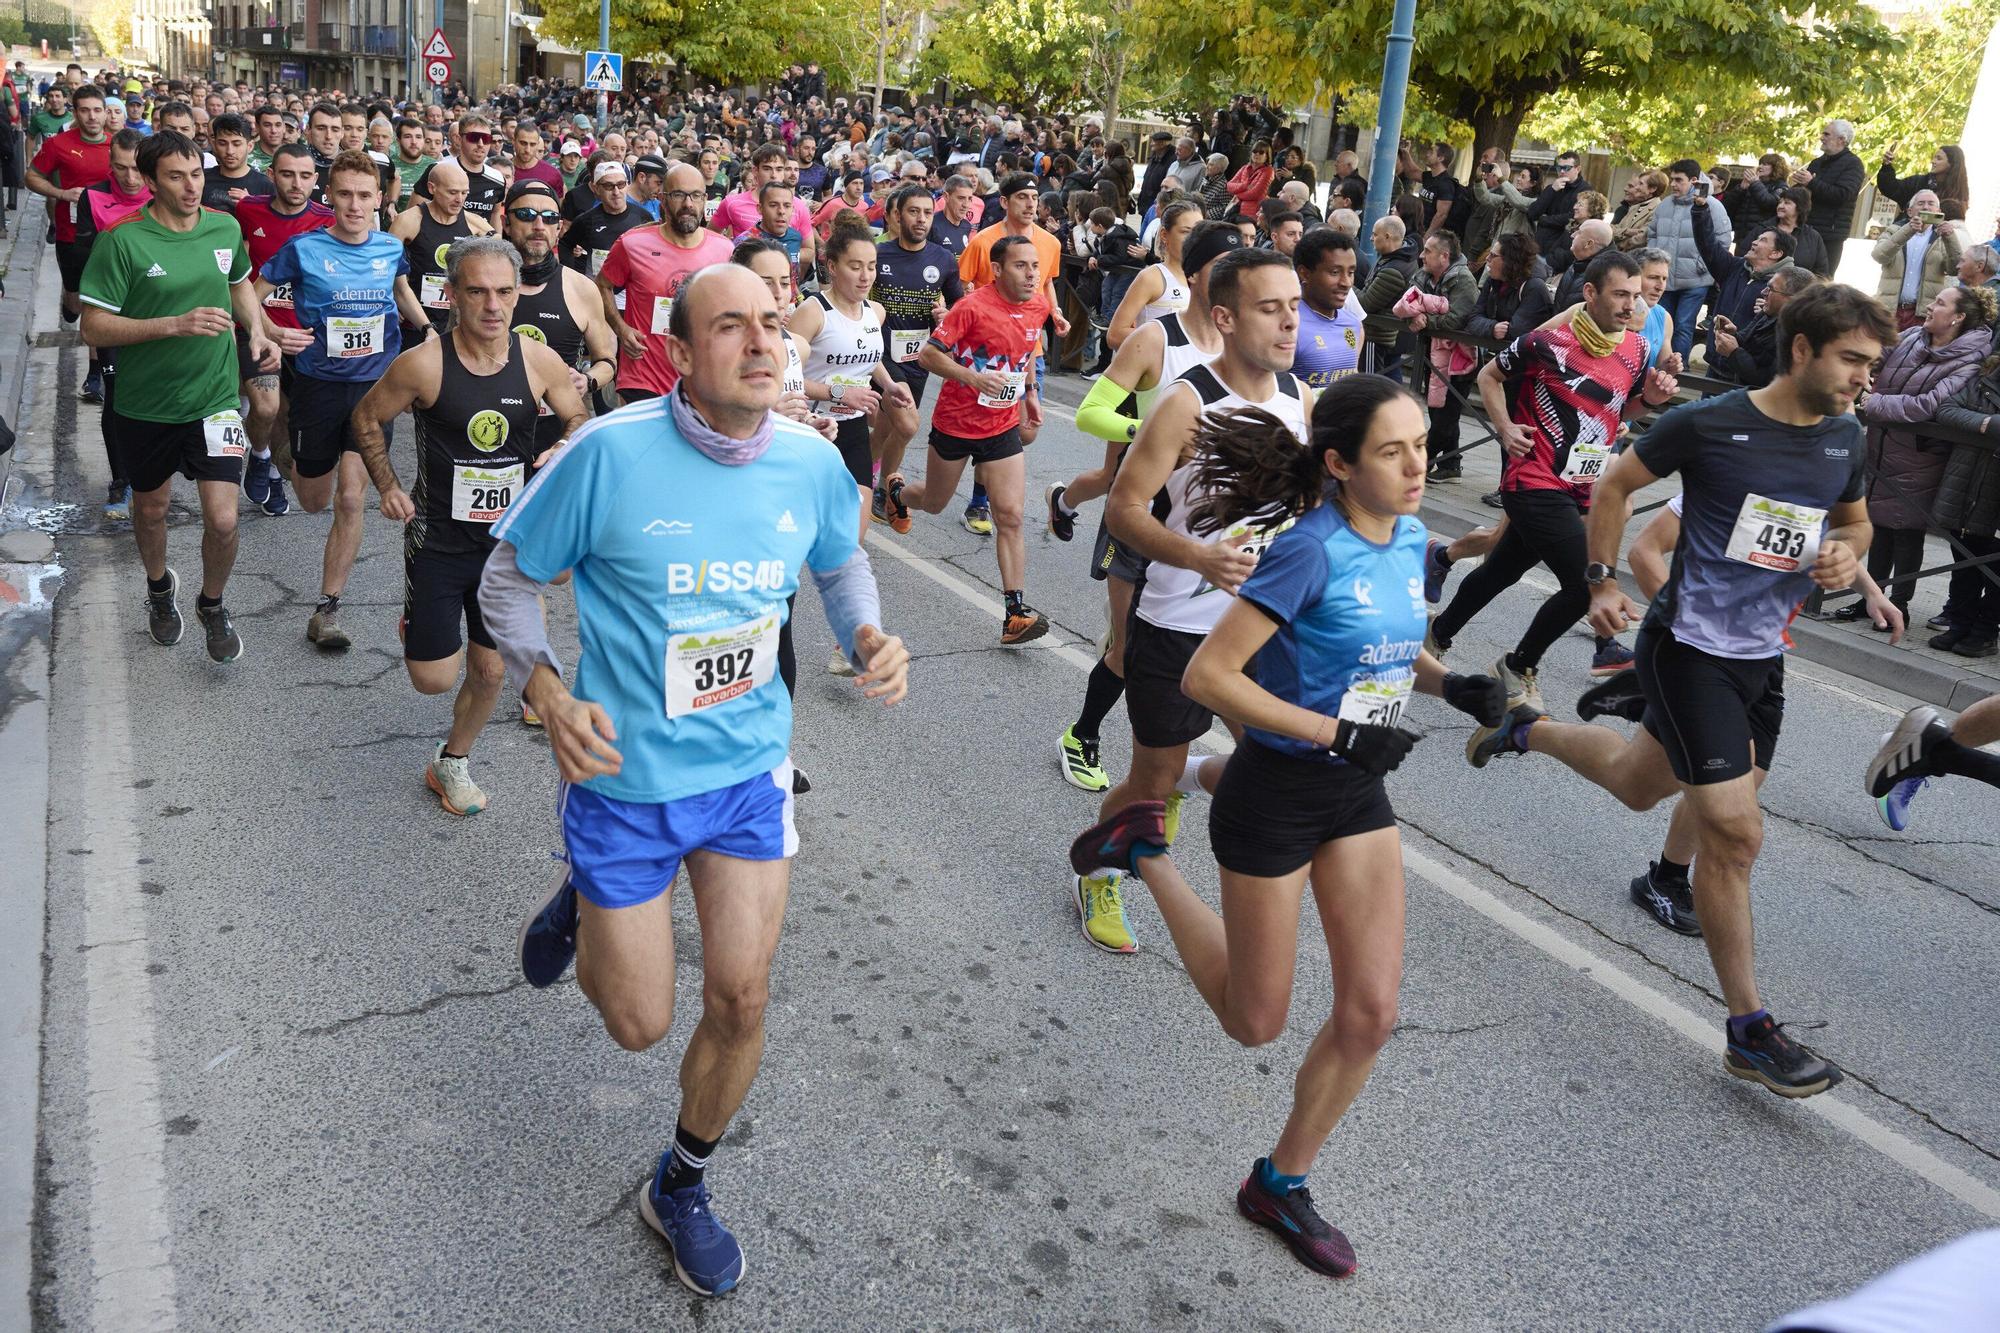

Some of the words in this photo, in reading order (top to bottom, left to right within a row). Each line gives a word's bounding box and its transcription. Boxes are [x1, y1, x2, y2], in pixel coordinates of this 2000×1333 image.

[432, 67, 445, 77] 30
[332, 286, 386, 301] adentro
[331, 303, 384, 311] construimos
[343, 331, 371, 349] 313
[906, 341, 920, 354] 62
[994, 386, 1016, 401] 05
[1579, 459, 1603, 475] 185
[471, 487, 511, 511] 260
[1755, 524, 1806, 558] 433
[695, 648, 754, 691] 392
[696, 682, 751, 707] navarban
